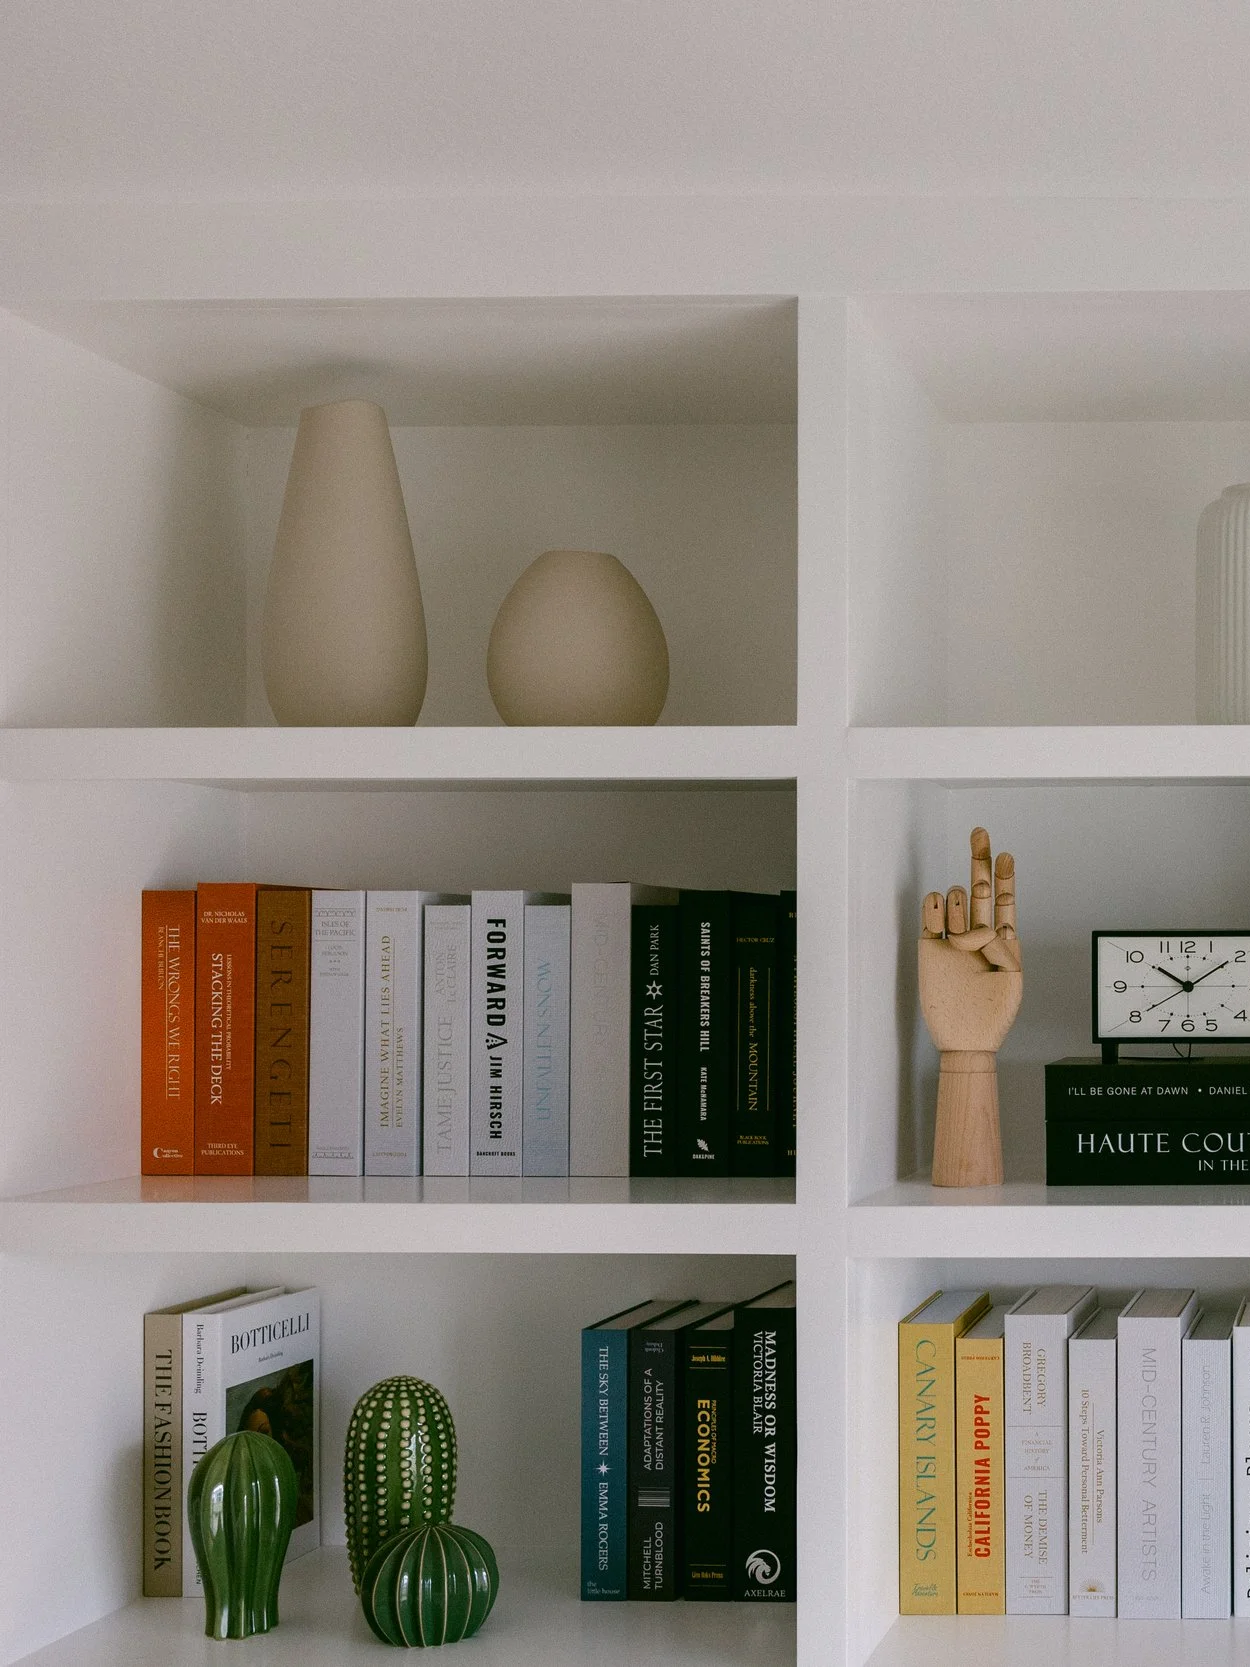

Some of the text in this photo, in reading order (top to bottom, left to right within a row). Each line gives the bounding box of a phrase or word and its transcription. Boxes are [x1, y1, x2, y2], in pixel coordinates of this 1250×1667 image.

[487, 919, 506, 1026] FORWARD
[650, 924, 659, 976] DAN PARK
[1126, 950, 1144, 963] 10
[1160, 941, 1169, 953] 11
[1180, 941, 1196, 953] 12
[1234, 950, 1246, 963] 2
[168, 925, 181, 1098] THE WRONGS WE RIGHT
[700, 922, 711, 1052] SAINTS OF BREAKERS HILL
[1113, 980, 1127, 993] 9
[1129, 1011, 1142, 1023] 8
[1233, 1010, 1247, 1021] 4
[211, 953, 223, 1104] STACKING THE DECK
[270, 919, 294, 1147] SERENGETI
[380, 935, 390, 1127] IMAGINE WHAT LIES AHEAD
[396, 1027, 404, 1086] MATTHEWS
[748, 967, 758, 1111] darkness above the MOUNTAIN
[1159, 1020, 1171, 1032] 7
[1181, 1020, 1195, 1032] 6
[1205, 1020, 1218, 1032] 5
[489, 1056, 502, 1139] JIM HIRSCH
[643, 1004, 664, 1157] THE FIRST STAR
[1068, 1086, 1188, 1096] I'LL BE GONE AT DAWN
[1209, 1086, 1247, 1095] DANIEL
[1078, 1133, 1170, 1153] HAUTE
[1198, 1160, 1214, 1171] IN
[1220, 1159, 1248, 1171] THE
[230, 1313, 310, 1354] BOTTICELLI
[599, 1346, 609, 1456] THE SKY BETWEEN
[753, 1331, 763, 1434] VICTORIA BLAIR
[697, 1400, 710, 1512] ECONOMICS
[764, 1331, 776, 1512] MADNESS OR WISDOM
[916, 1340, 936, 1561] CANARY ISLANDS
[154, 1349, 172, 1572] THE FASHION BOOK
[974, 1394, 991, 1558] CALIFORNIA POPPY
[1142, 1347, 1158, 1582] MID-CENTURY ARTISTS
[598, 1482, 608, 1570] EMMA ROGERS
[744, 1589, 786, 1597] AXELRAE
